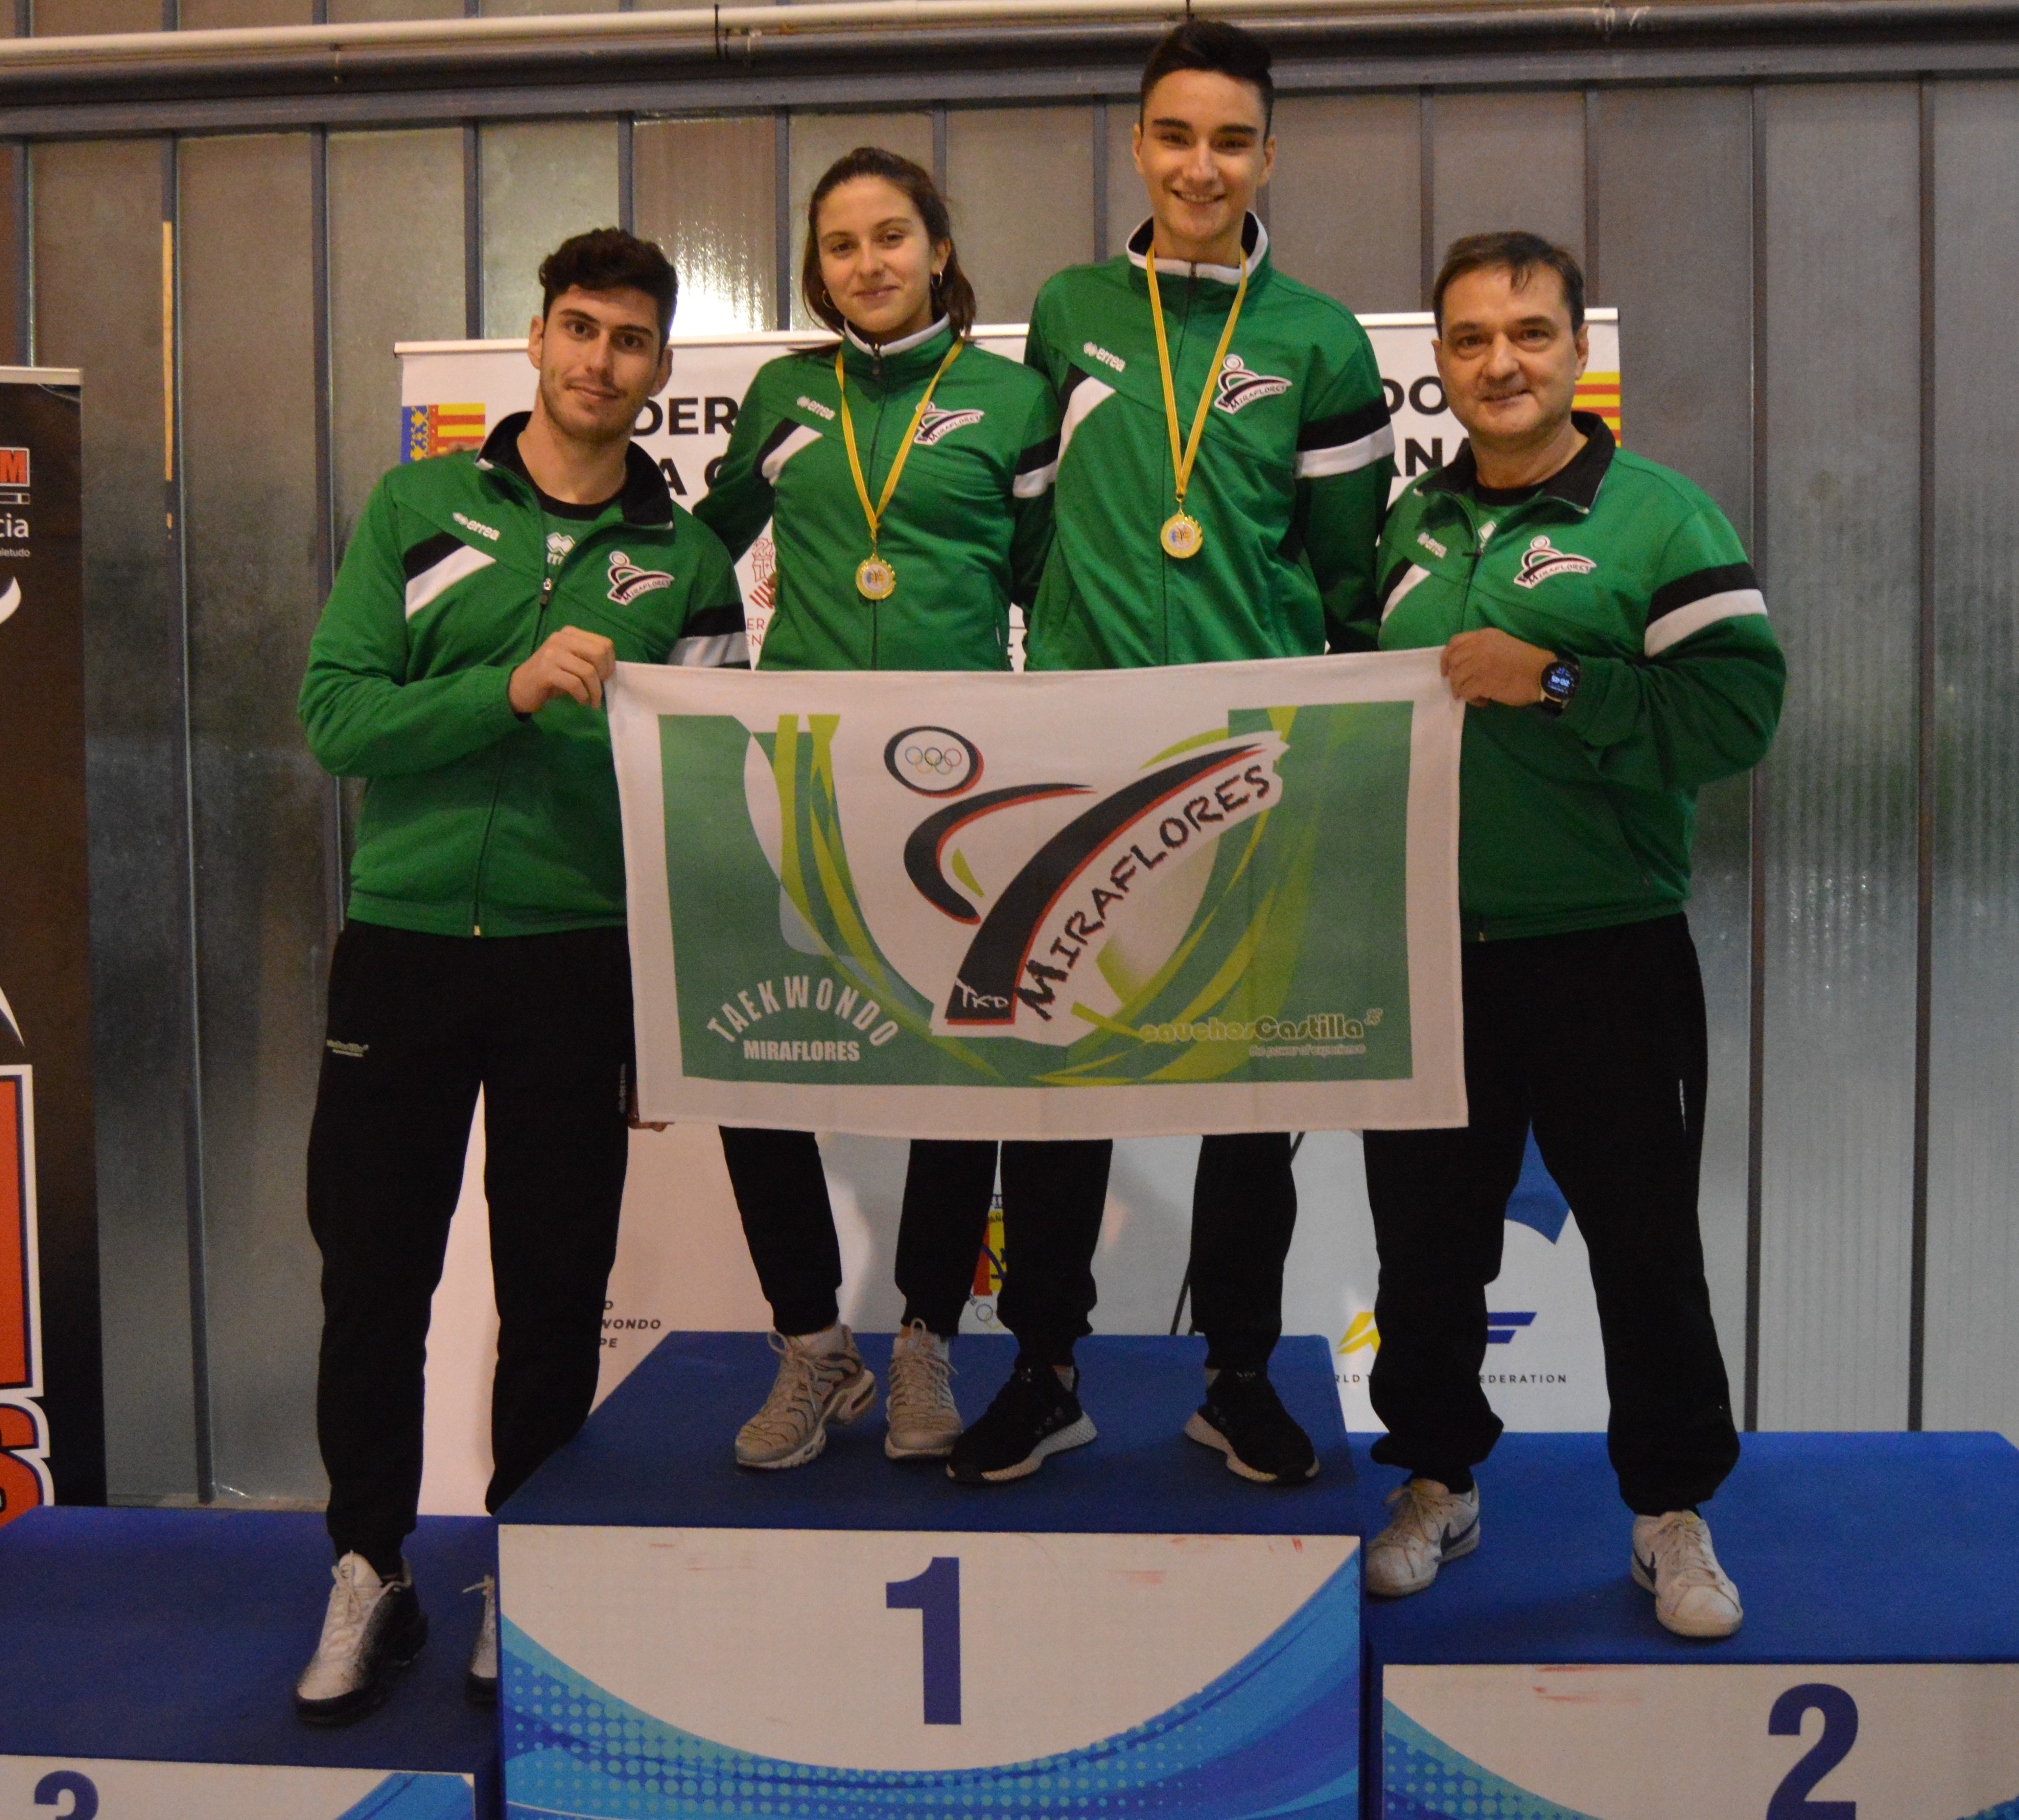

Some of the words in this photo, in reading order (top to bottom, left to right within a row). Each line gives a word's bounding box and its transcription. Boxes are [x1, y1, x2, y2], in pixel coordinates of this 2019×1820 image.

[633, 397, 738, 437] DER
[1381, 376, 1449, 415] DO
[1014, 765, 1271, 1022] MIRAFLORES
[707, 975, 899, 1046] TAEKWONDO
[743, 1040, 860, 1062] MIRAFLORES
[1479, 1374, 1567, 1384] EDERATION
[886, 1557, 962, 1725] 1
[1766, 1683, 1858, 1820] 2
